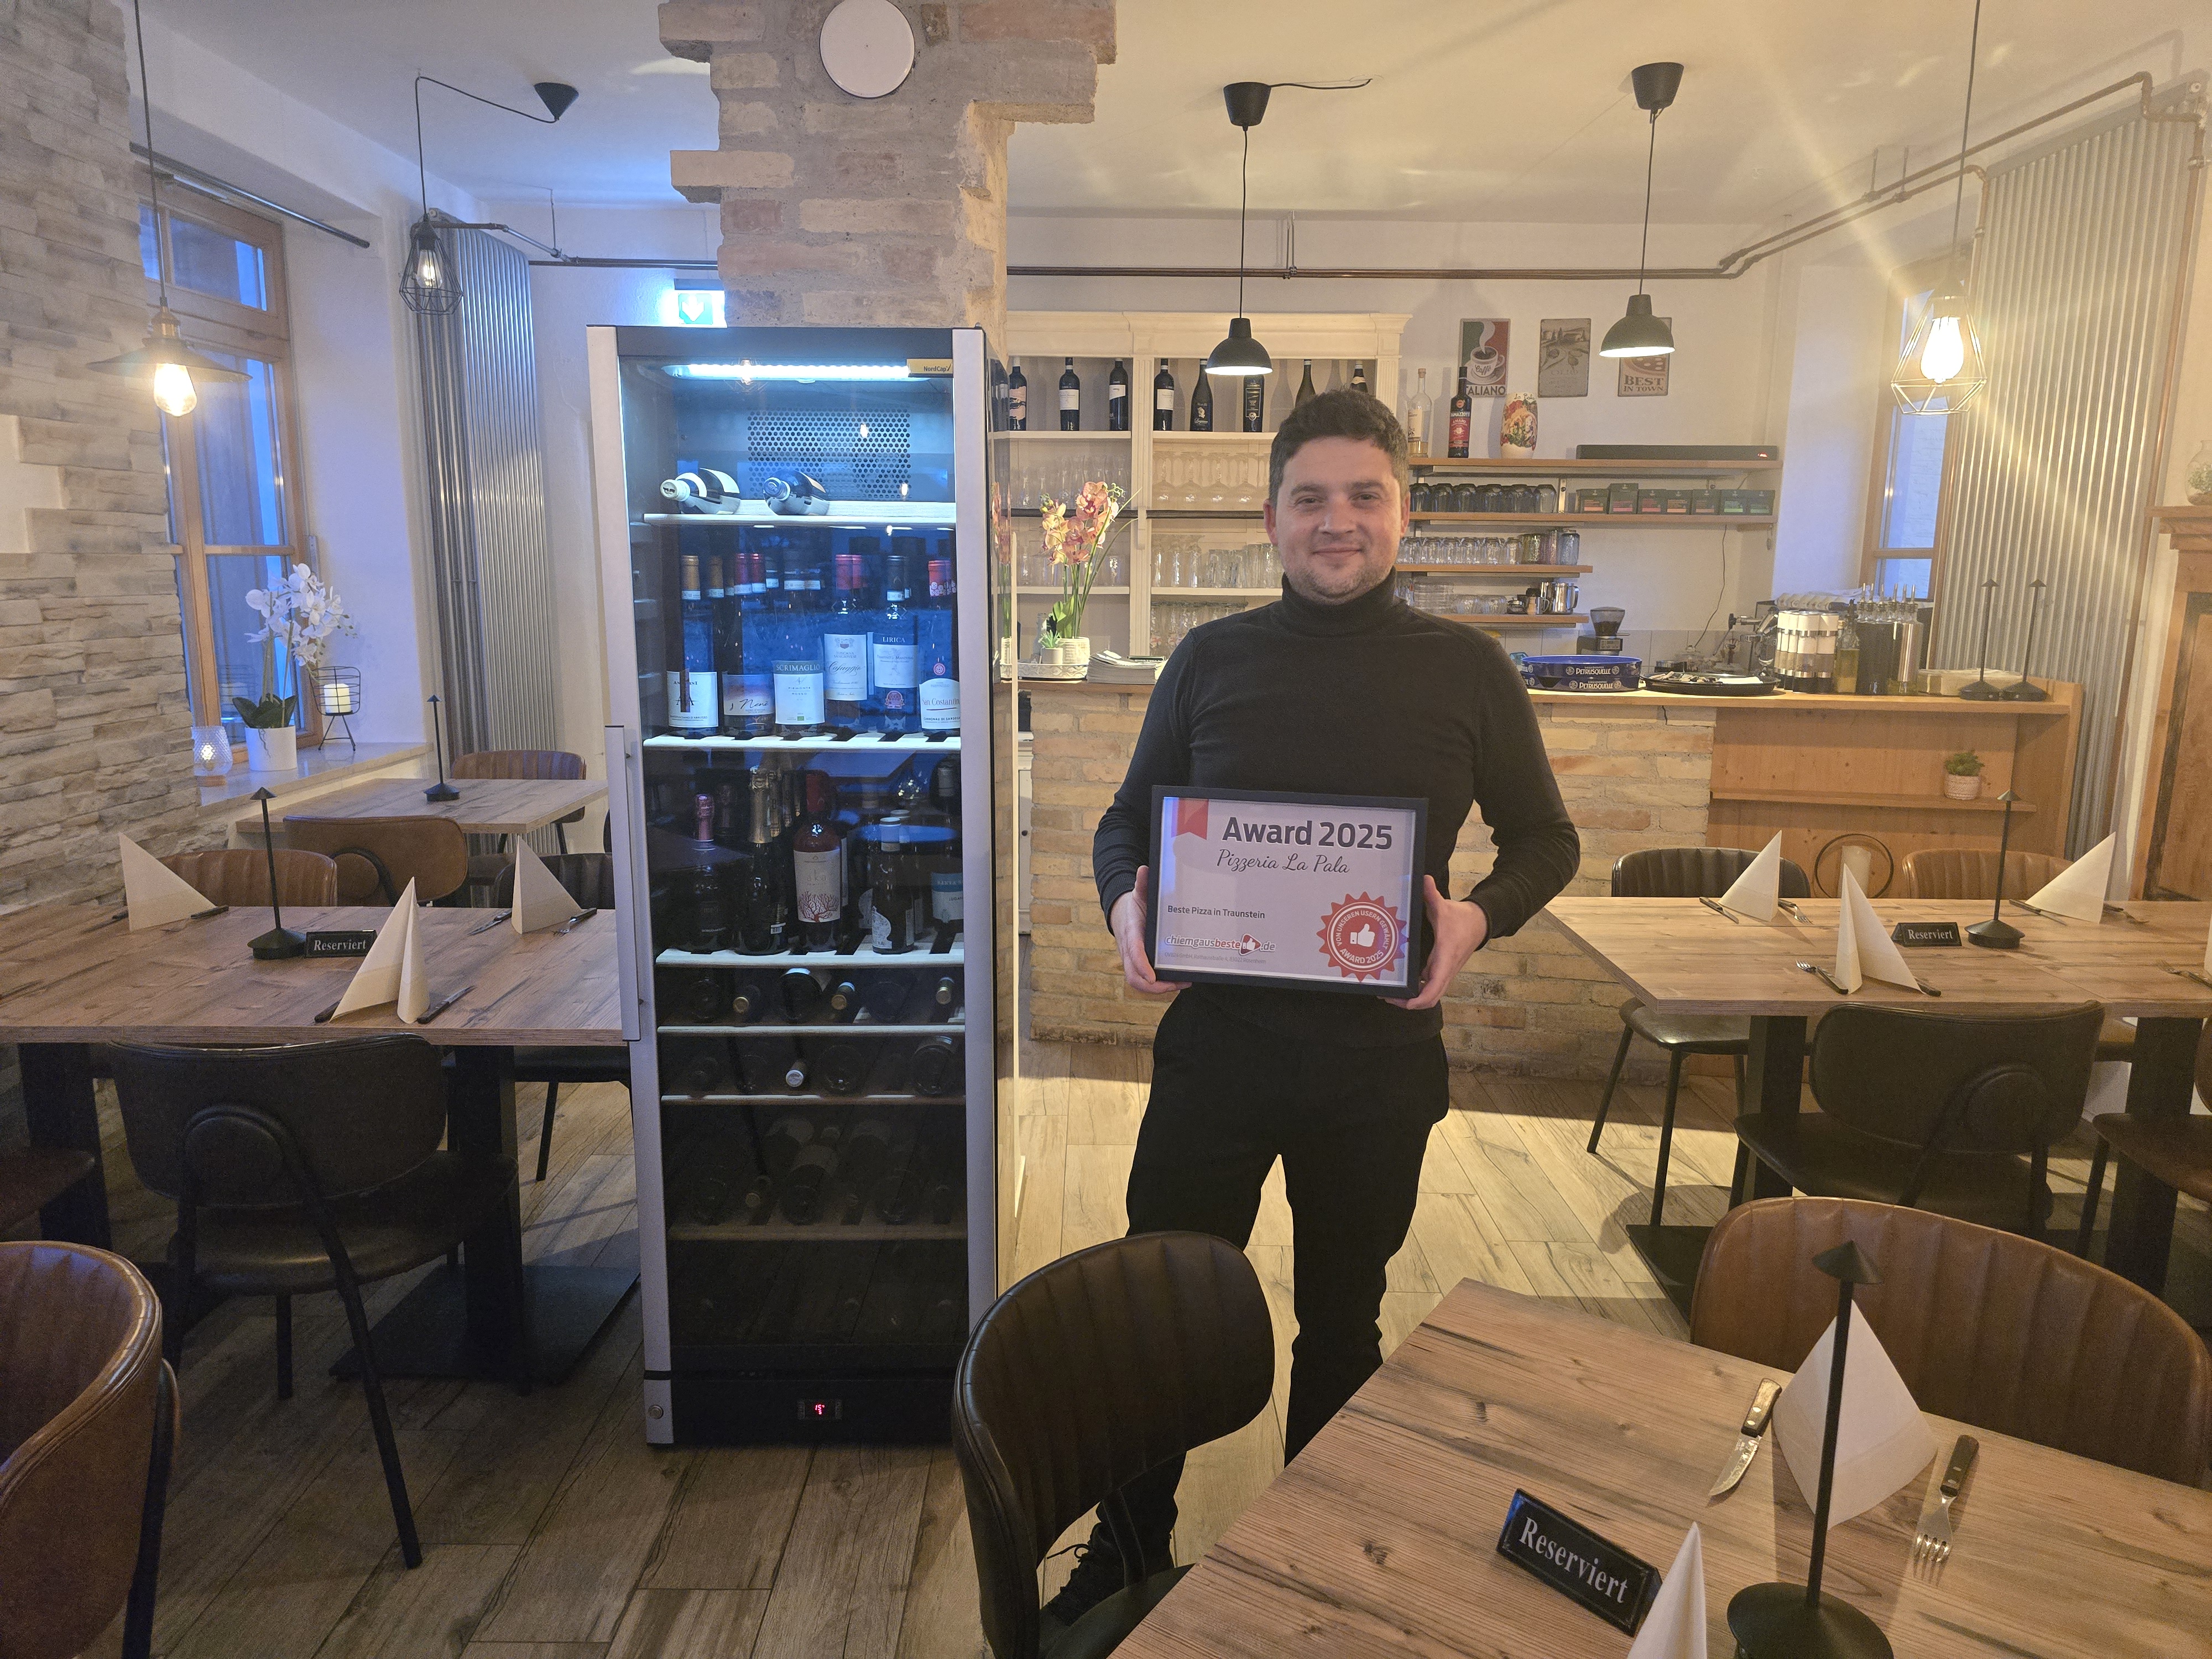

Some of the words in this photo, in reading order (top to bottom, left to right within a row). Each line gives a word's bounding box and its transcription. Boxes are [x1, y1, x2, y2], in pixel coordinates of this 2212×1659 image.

[1624, 374, 1664, 386] BEST
[1222, 817, 1312, 845] Award
[1318, 822, 1392, 850] 2025
[1217, 849, 1279, 872] Pizzeria
[1282, 853, 1308, 870] La
[1313, 854, 1350, 873] Pala
[1167, 905, 1190, 914] Beste
[1192, 907, 1212, 915] Pizza
[1222, 909, 1265, 919] Traunstein
[1337, 911, 1360, 932] UNSEREN
[1360, 910, 1381, 922] USERN
[1379, 919, 1391, 950] GEWÄHLT
[1908, 929, 1953, 940] Reserviert
[314, 940, 366, 951] Reserviert
[1340, 948, 1365, 964] AWARD
[1366, 950, 1384, 963] 2025
[1519, 1517, 1627, 1604] Reserviert
